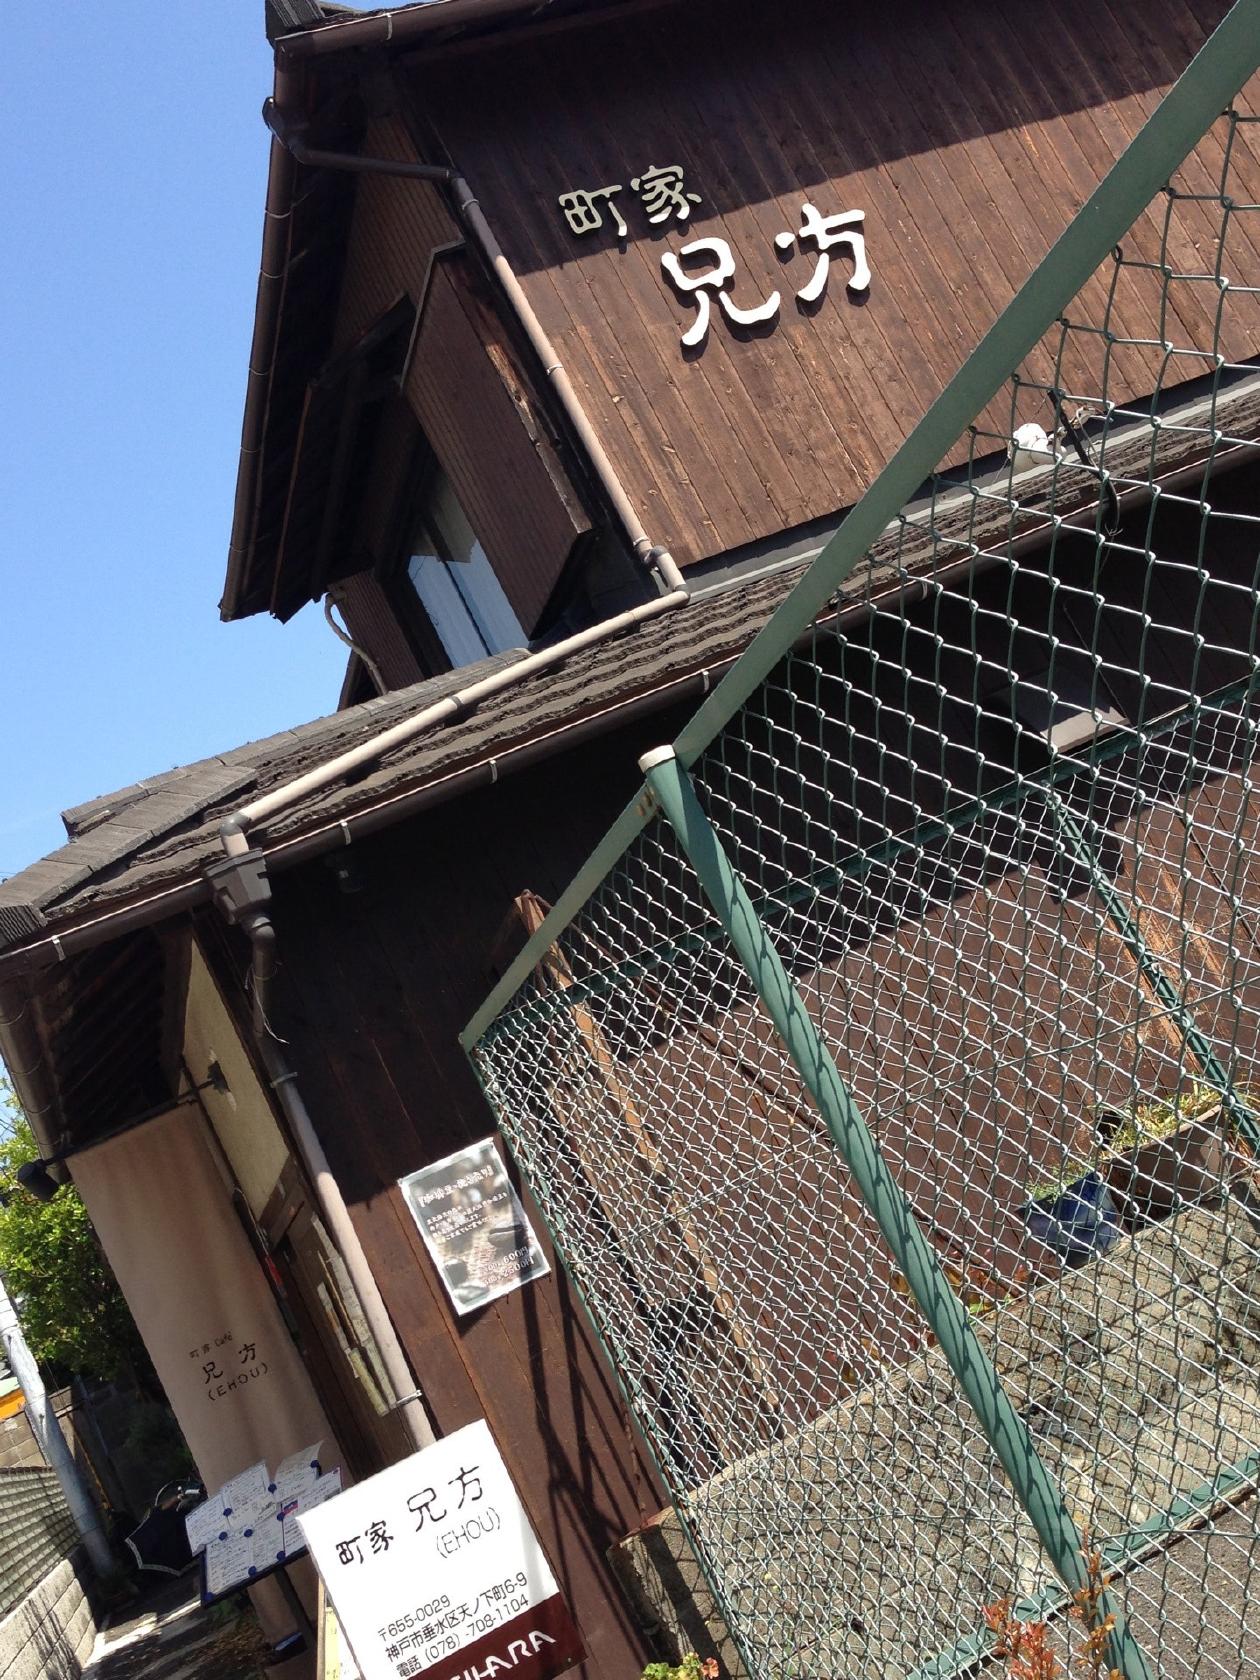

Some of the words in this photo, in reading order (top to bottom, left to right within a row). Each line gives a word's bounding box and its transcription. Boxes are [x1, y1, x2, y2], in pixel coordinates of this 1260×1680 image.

[558, 164, 703, 237] 町家
[661, 203, 872, 346] 兄方
[202, 1343, 256, 1385] 兄方
[208, 1362, 268, 1401] (EHOU)
[335, 1520, 394, 1566] 町家
[406, 1466, 483, 1533] 兄方
[436, 1507, 501, 1559] (EHOU)
[378, 1594, 451, 1642] 〒655-0029
[385, 1571, 528, 1663] 神戸市垂水区天ノ下町6-9
